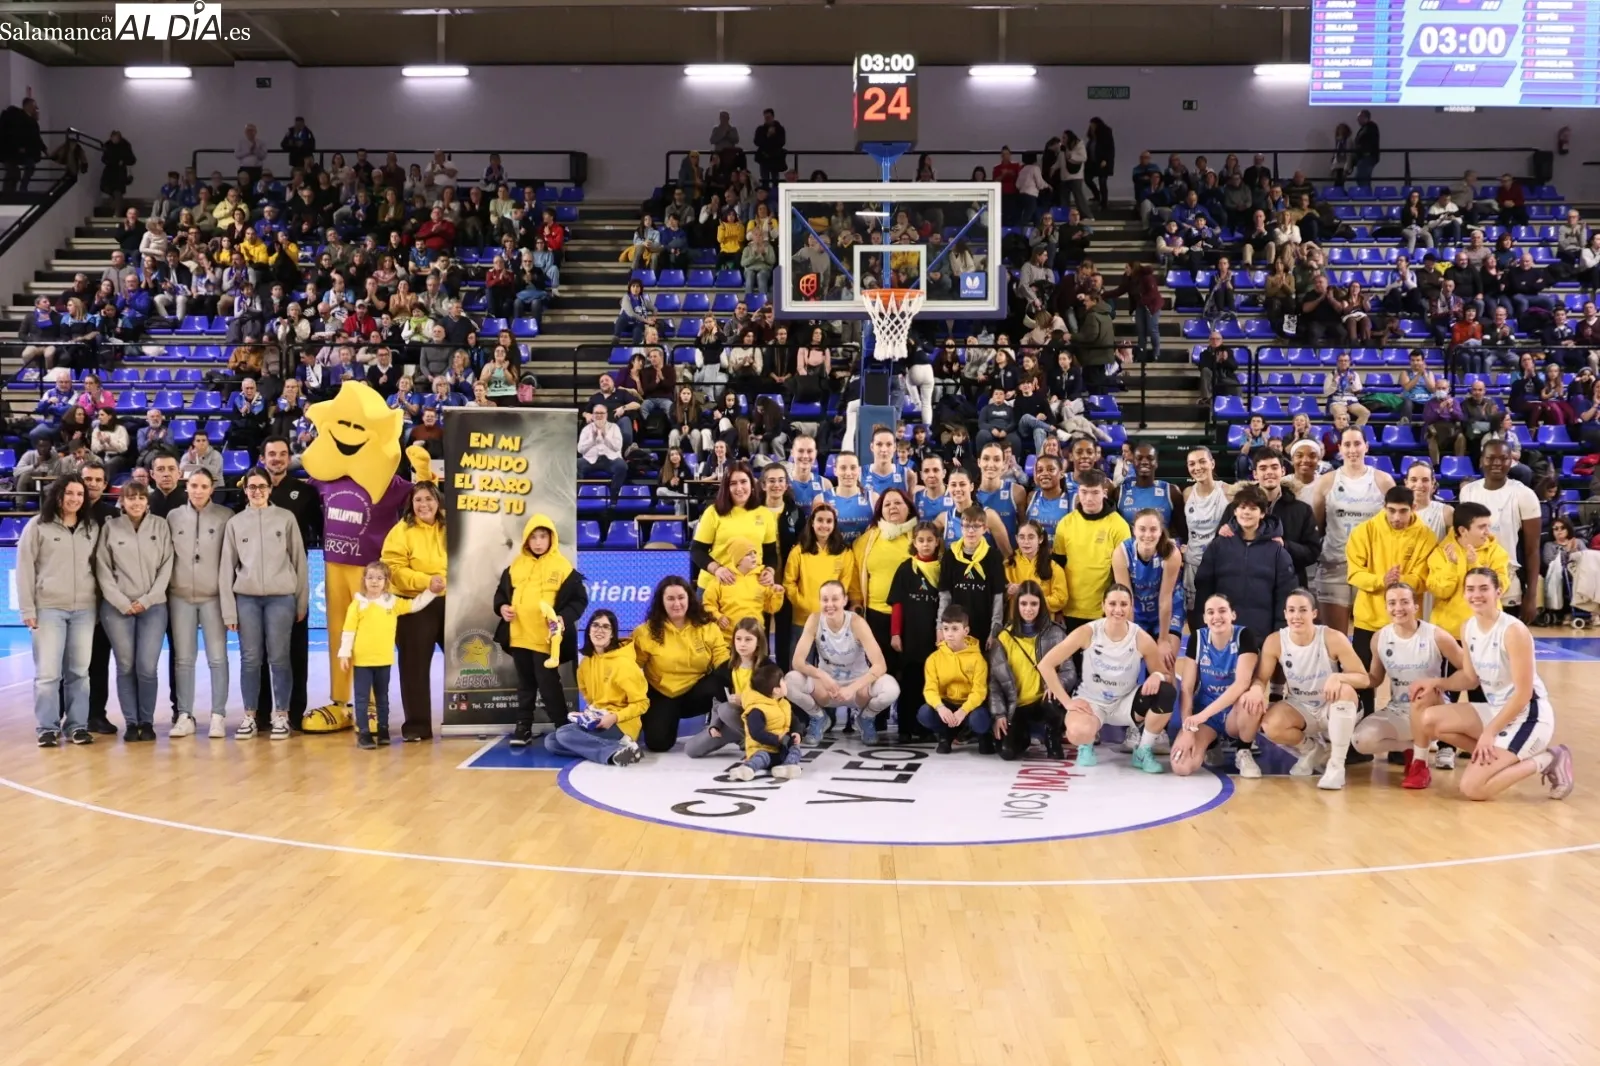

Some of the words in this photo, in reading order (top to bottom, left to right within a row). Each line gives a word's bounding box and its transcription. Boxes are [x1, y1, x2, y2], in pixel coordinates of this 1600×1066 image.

[1419, 26, 1506, 55] 03:00
[860, 53, 915, 72] 03:00
[863, 86, 912, 121] 24
[469, 432, 495, 449] EN
[497, 434, 522, 452] MI
[459, 451, 528, 474] MUNDO
[454, 473, 474, 490] EL
[478, 474, 532, 495] RARO
[456, 494, 500, 513] ERES
[503, 499, 526, 515] TU
[806, 789, 916, 805] Y
[1001, 792, 1052, 820] NOS
